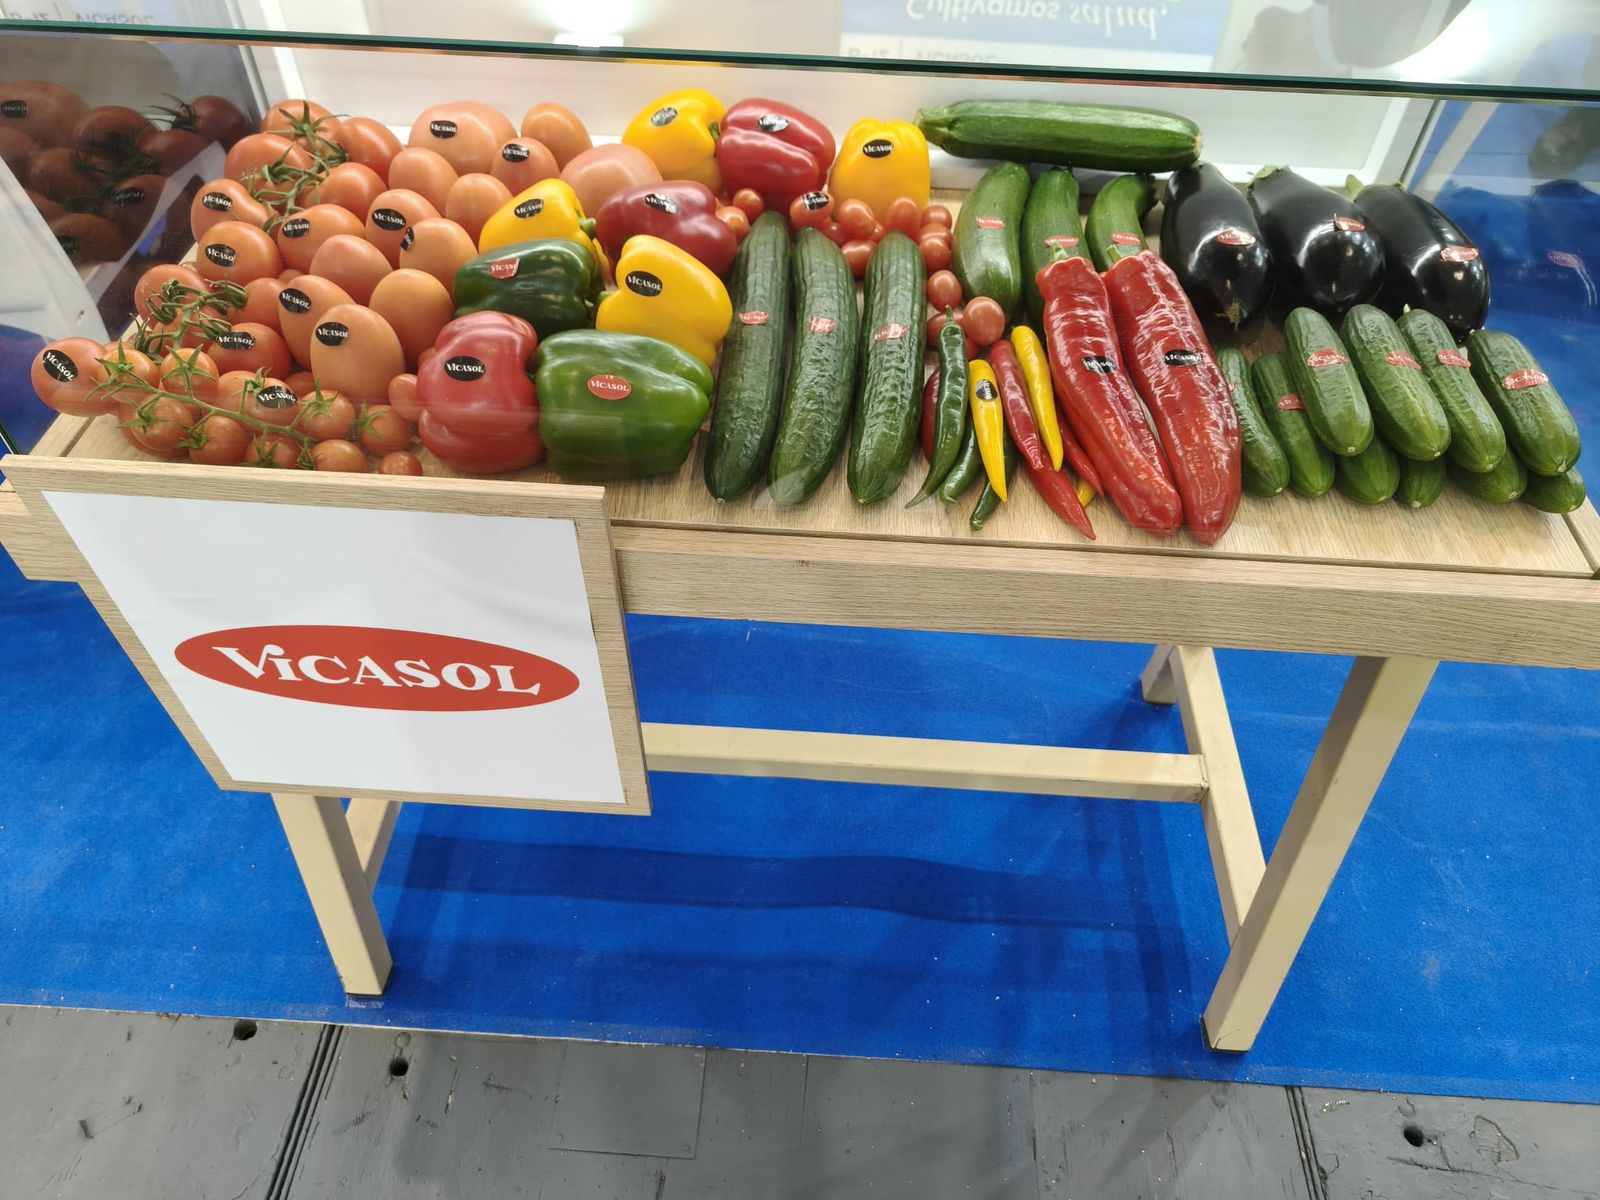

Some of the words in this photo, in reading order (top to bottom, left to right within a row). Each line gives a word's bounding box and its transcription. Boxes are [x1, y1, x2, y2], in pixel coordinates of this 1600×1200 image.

[203, 195, 233, 209] VICASOL
[372, 212, 406, 226] VICASOL
[627, 275, 663, 291] VICASOL
[46, 350, 74, 382] VICASOL
[446, 362, 485, 374] VICASOL
[590, 379, 630, 393] VICASOL
[211, 643, 542, 696] VICASOL
